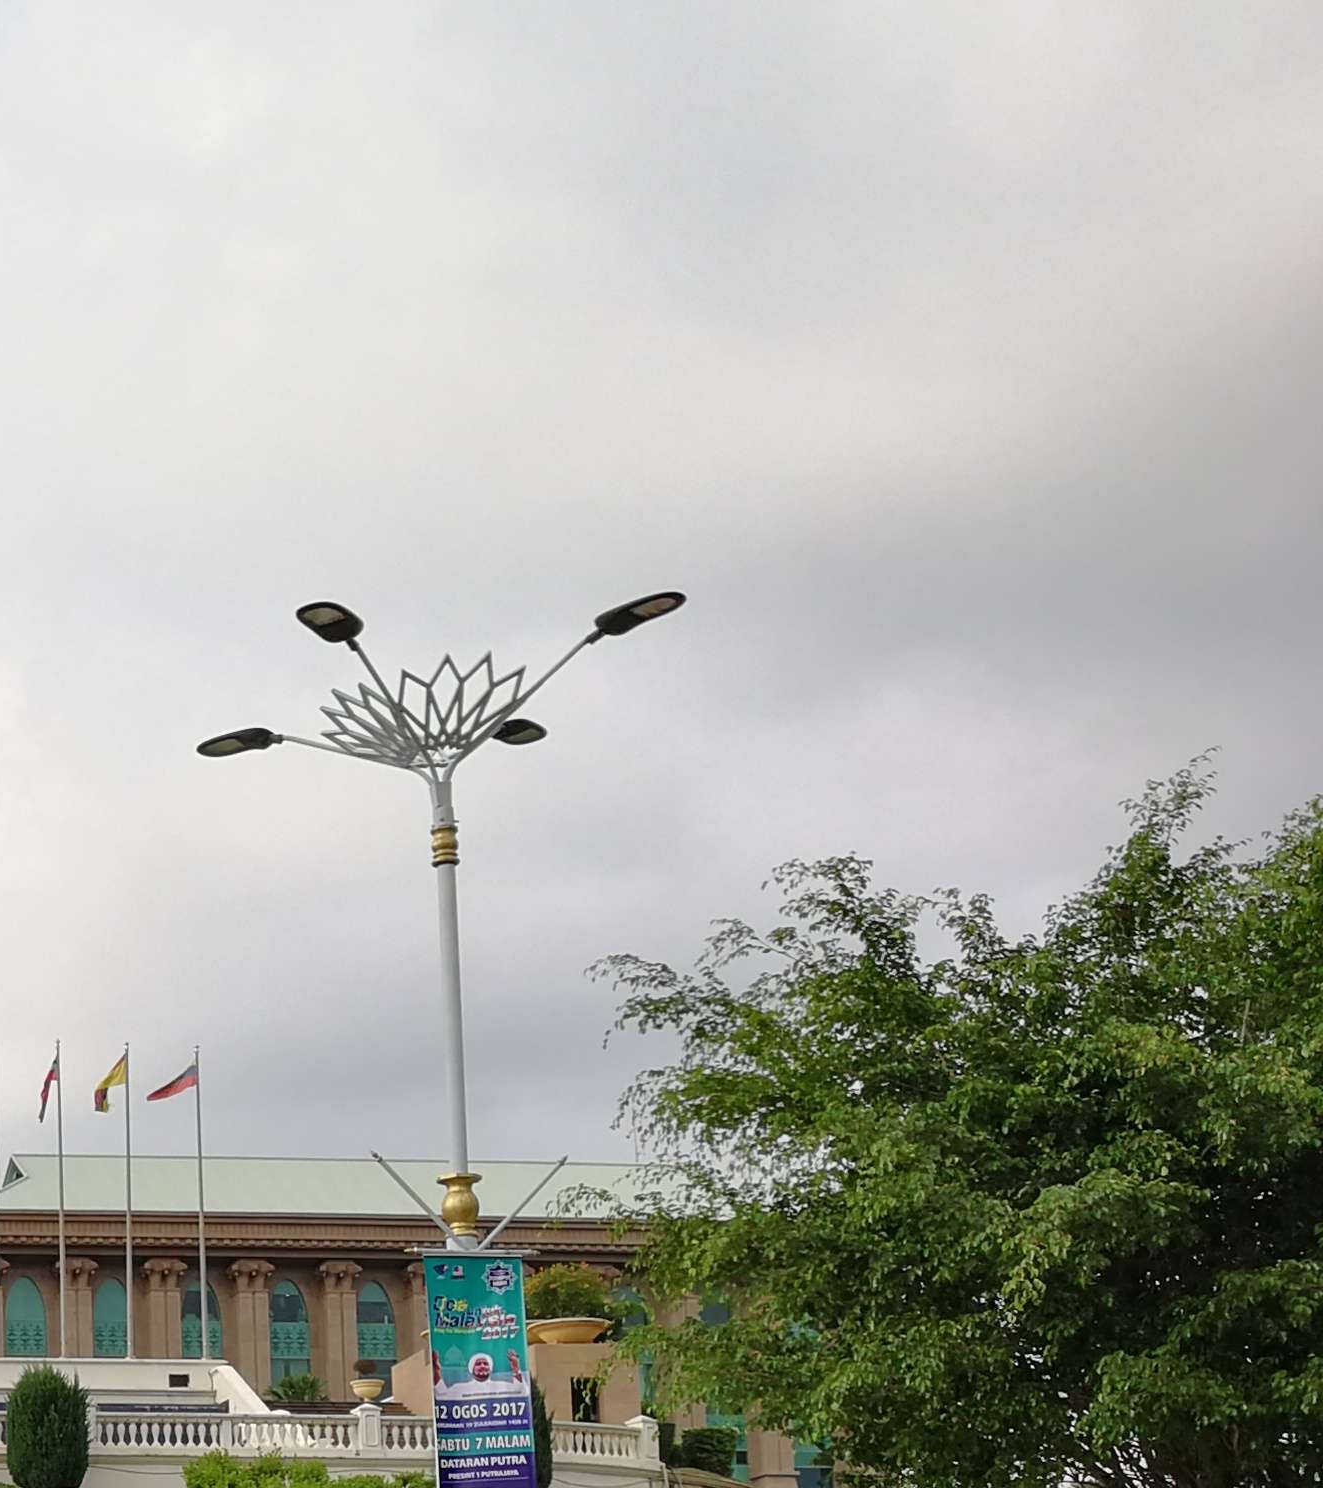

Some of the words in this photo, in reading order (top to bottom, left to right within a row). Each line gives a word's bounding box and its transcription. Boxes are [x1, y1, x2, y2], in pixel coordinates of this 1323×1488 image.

[436, 1405, 448, 1419] 12
[452, 1403, 488, 1419] OGOS
[492, 1402, 526, 1417] 2017
[436, 1438, 470, 1451] SABTU
[476, 1437, 483, 1450] 7
[486, 1434, 531, 1449] MALAM
[440, 1458, 489, 1469] DATARAN
[490, 1455, 527, 1467] PUTRA
